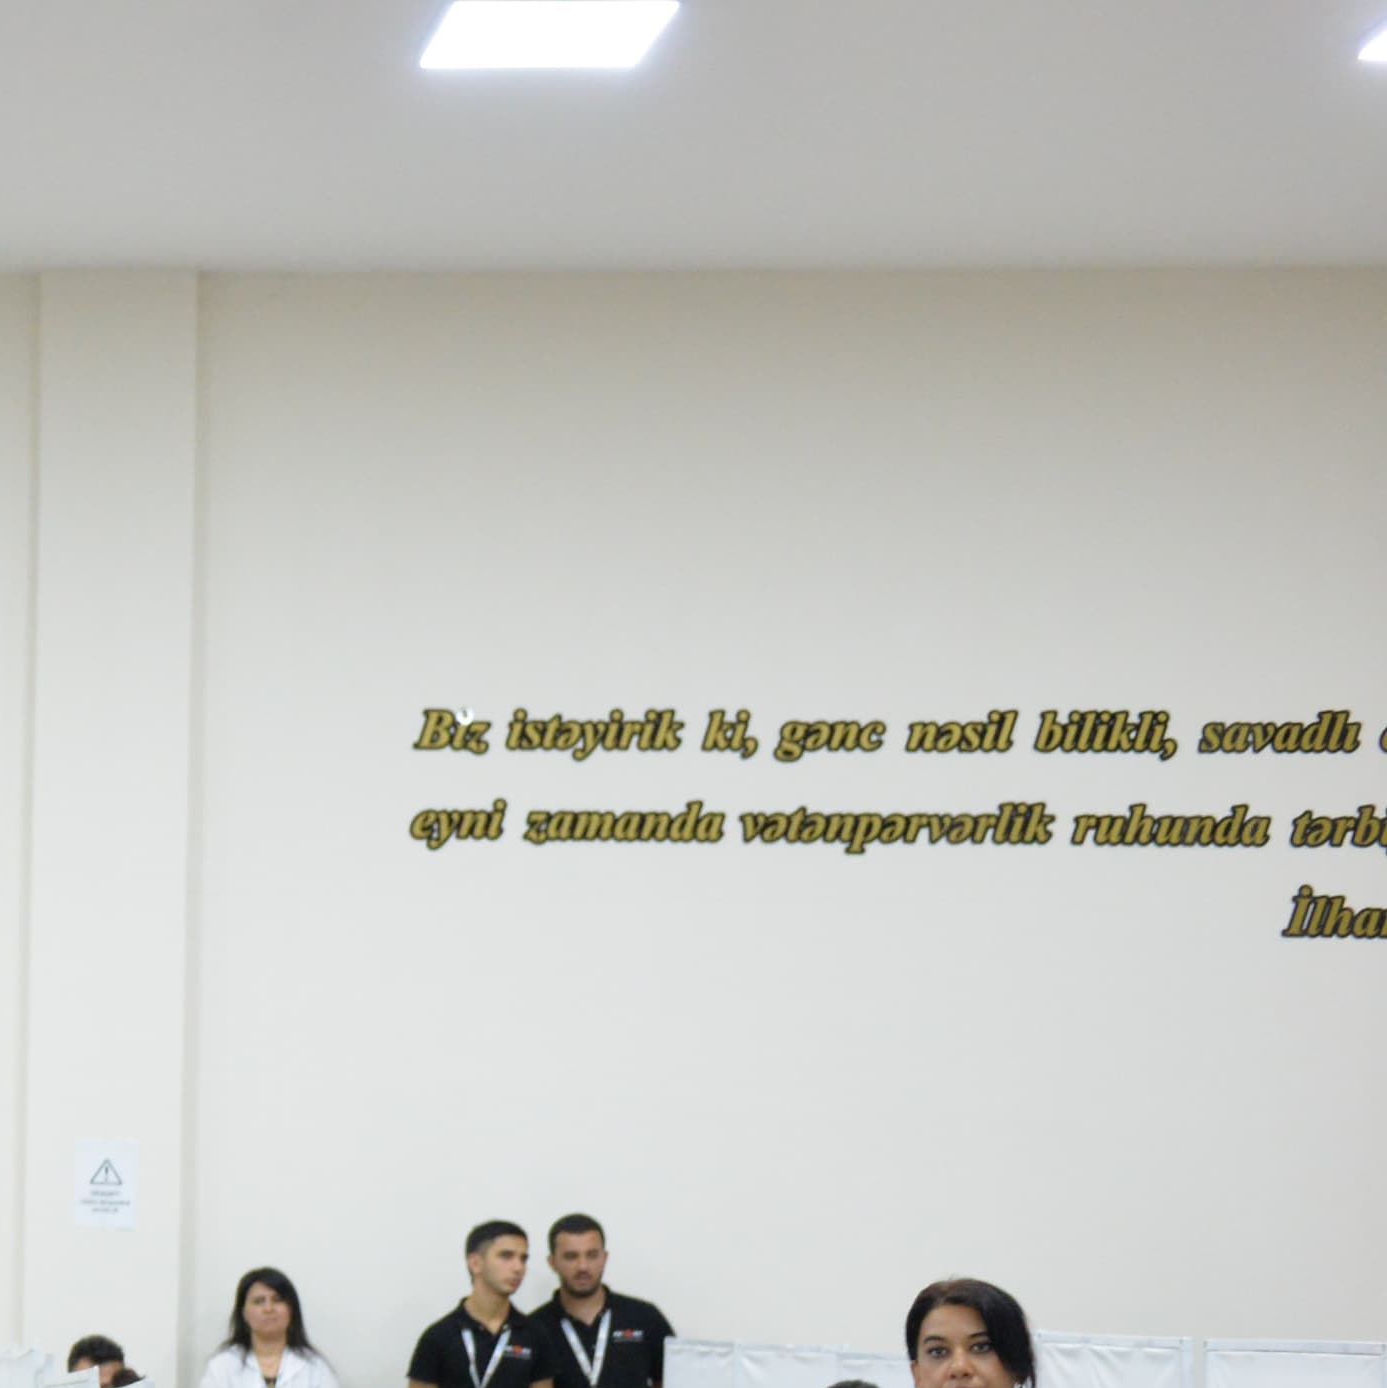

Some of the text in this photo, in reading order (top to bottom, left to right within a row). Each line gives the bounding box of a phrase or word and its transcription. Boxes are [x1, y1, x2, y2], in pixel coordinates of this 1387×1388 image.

[505, 708, 685, 762] istəyirik
[701, 709, 759, 760] ki,
[773, 720, 887, 763] gənc
[905, 709, 1019, 754] nəsil
[1033, 710, 1178, 762] bilikli,
[1197, 710, 1362, 754] savadlı
[409, 798, 508, 851] eyni
[522, 800, 726, 846] zamanda
[738, 801, 1056, 855] vətənpərvərlik
[1070, 803, 1272, 848] ruhunda
[1281, 884, 1387, 940] İlha
